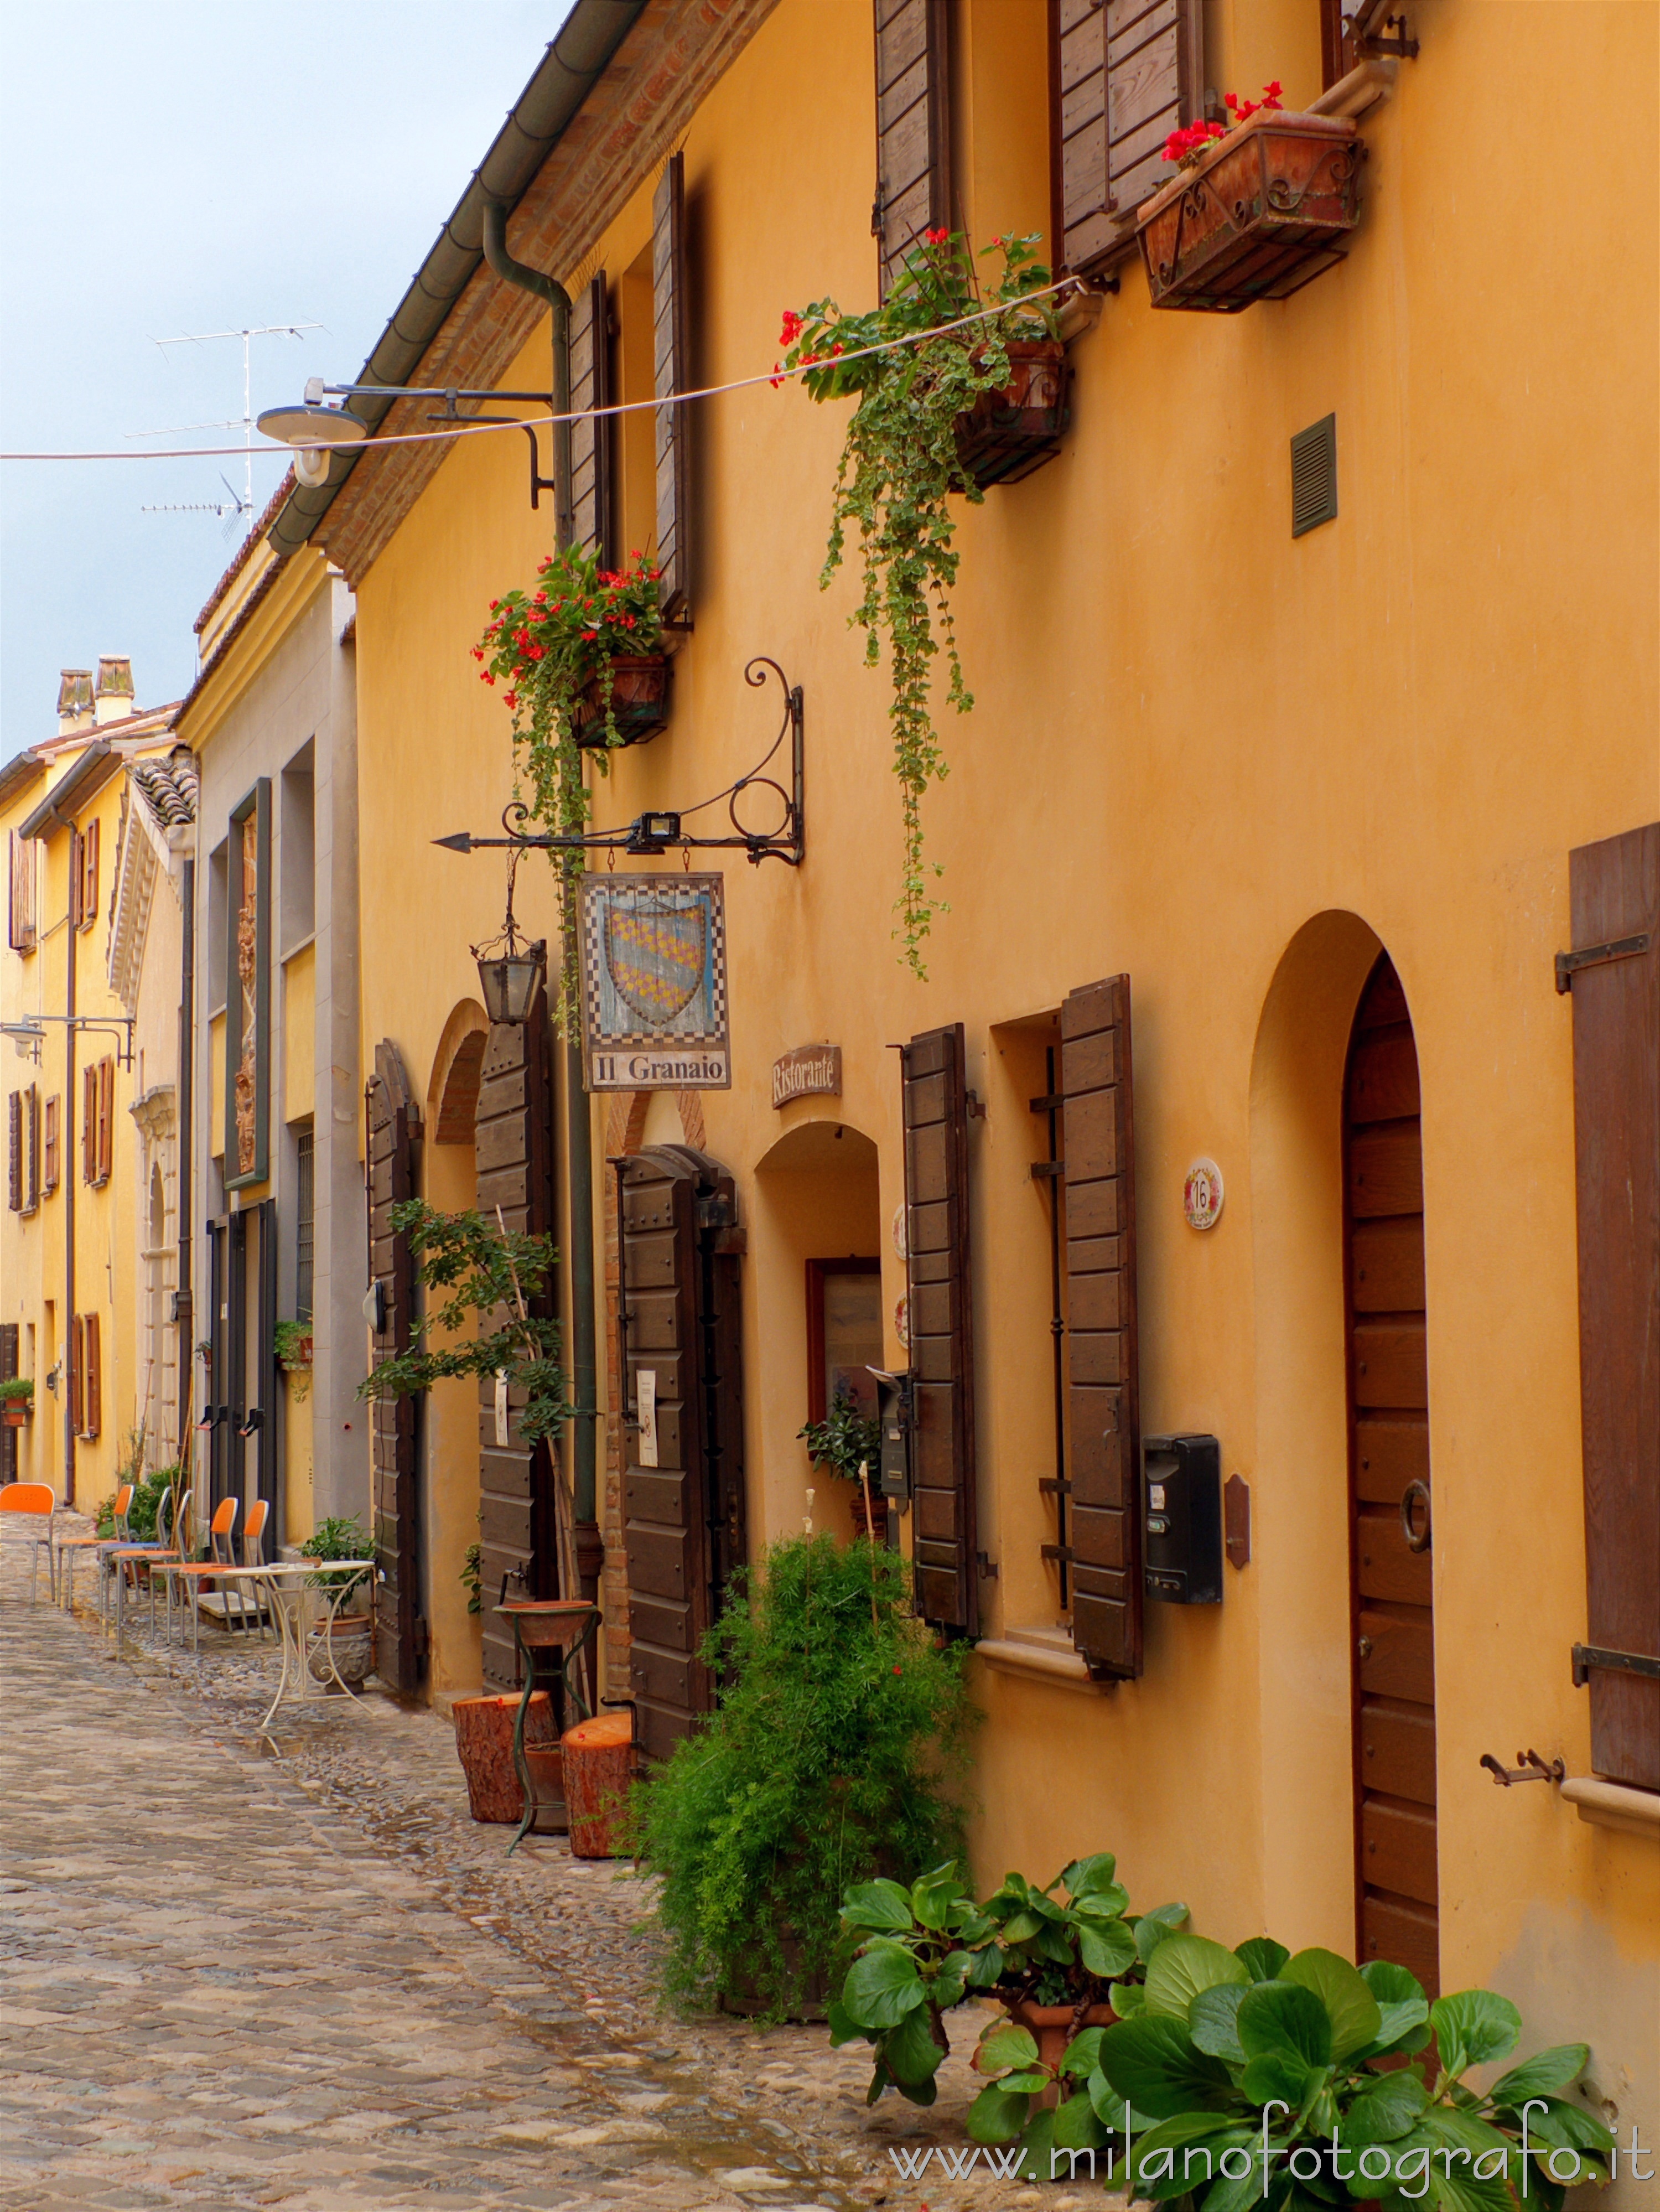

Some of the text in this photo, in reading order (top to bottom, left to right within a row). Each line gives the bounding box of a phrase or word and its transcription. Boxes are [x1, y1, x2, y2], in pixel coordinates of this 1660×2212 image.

[597, 1055, 723, 1081] Il Granaio
[773, 1054, 833, 1102] Ristorante
[1193, 1180, 1207, 1209] 16
